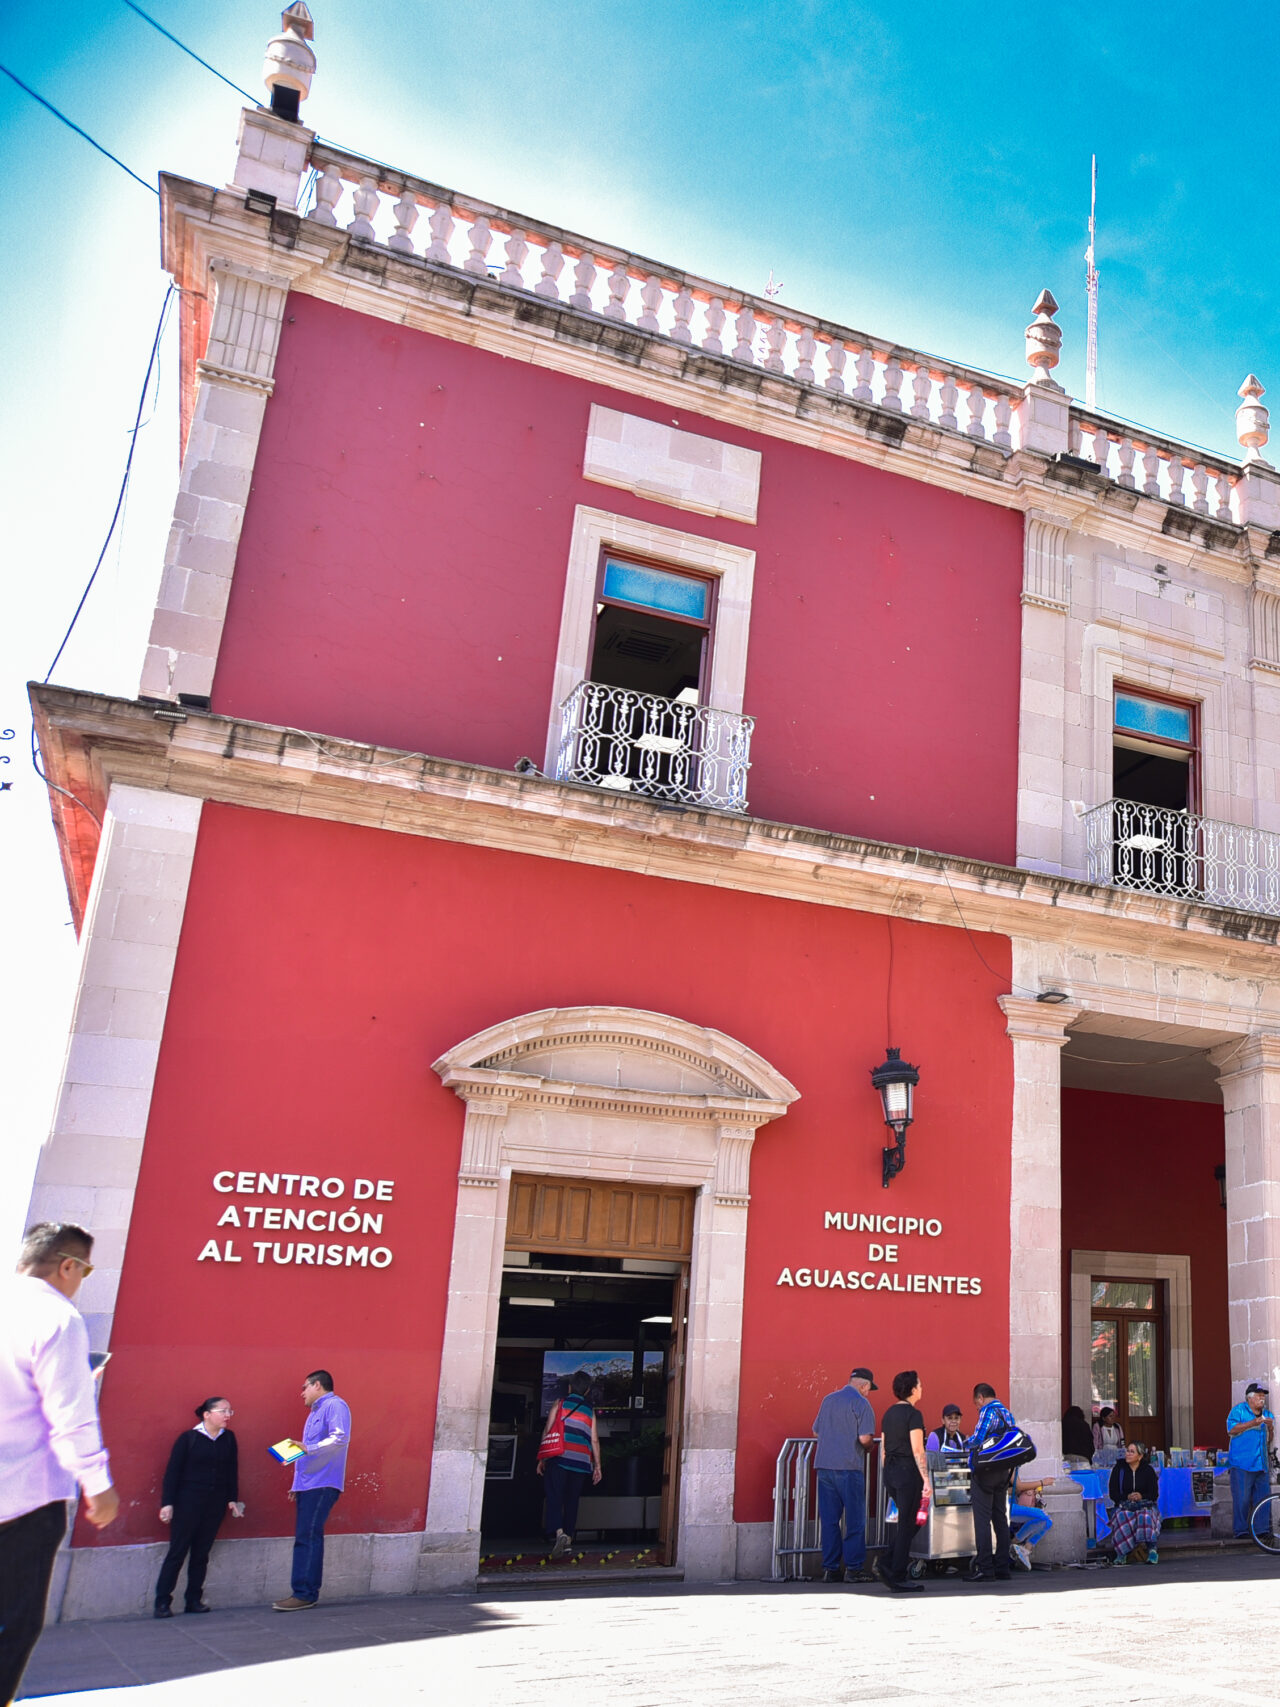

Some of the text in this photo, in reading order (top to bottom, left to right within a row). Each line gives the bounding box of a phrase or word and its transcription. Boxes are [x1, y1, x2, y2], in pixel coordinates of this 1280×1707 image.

[213, 1170, 395, 1201] CENTRO DE
[216, 1205, 383, 1234] ATENCIÓN
[824, 1211, 942, 1236] MUNICIPIO
[197, 1239, 393, 1268] AL TURISMO
[868, 1243, 898, 1262] DE
[776, 1267, 982, 1295] AGUASCALIENTES
